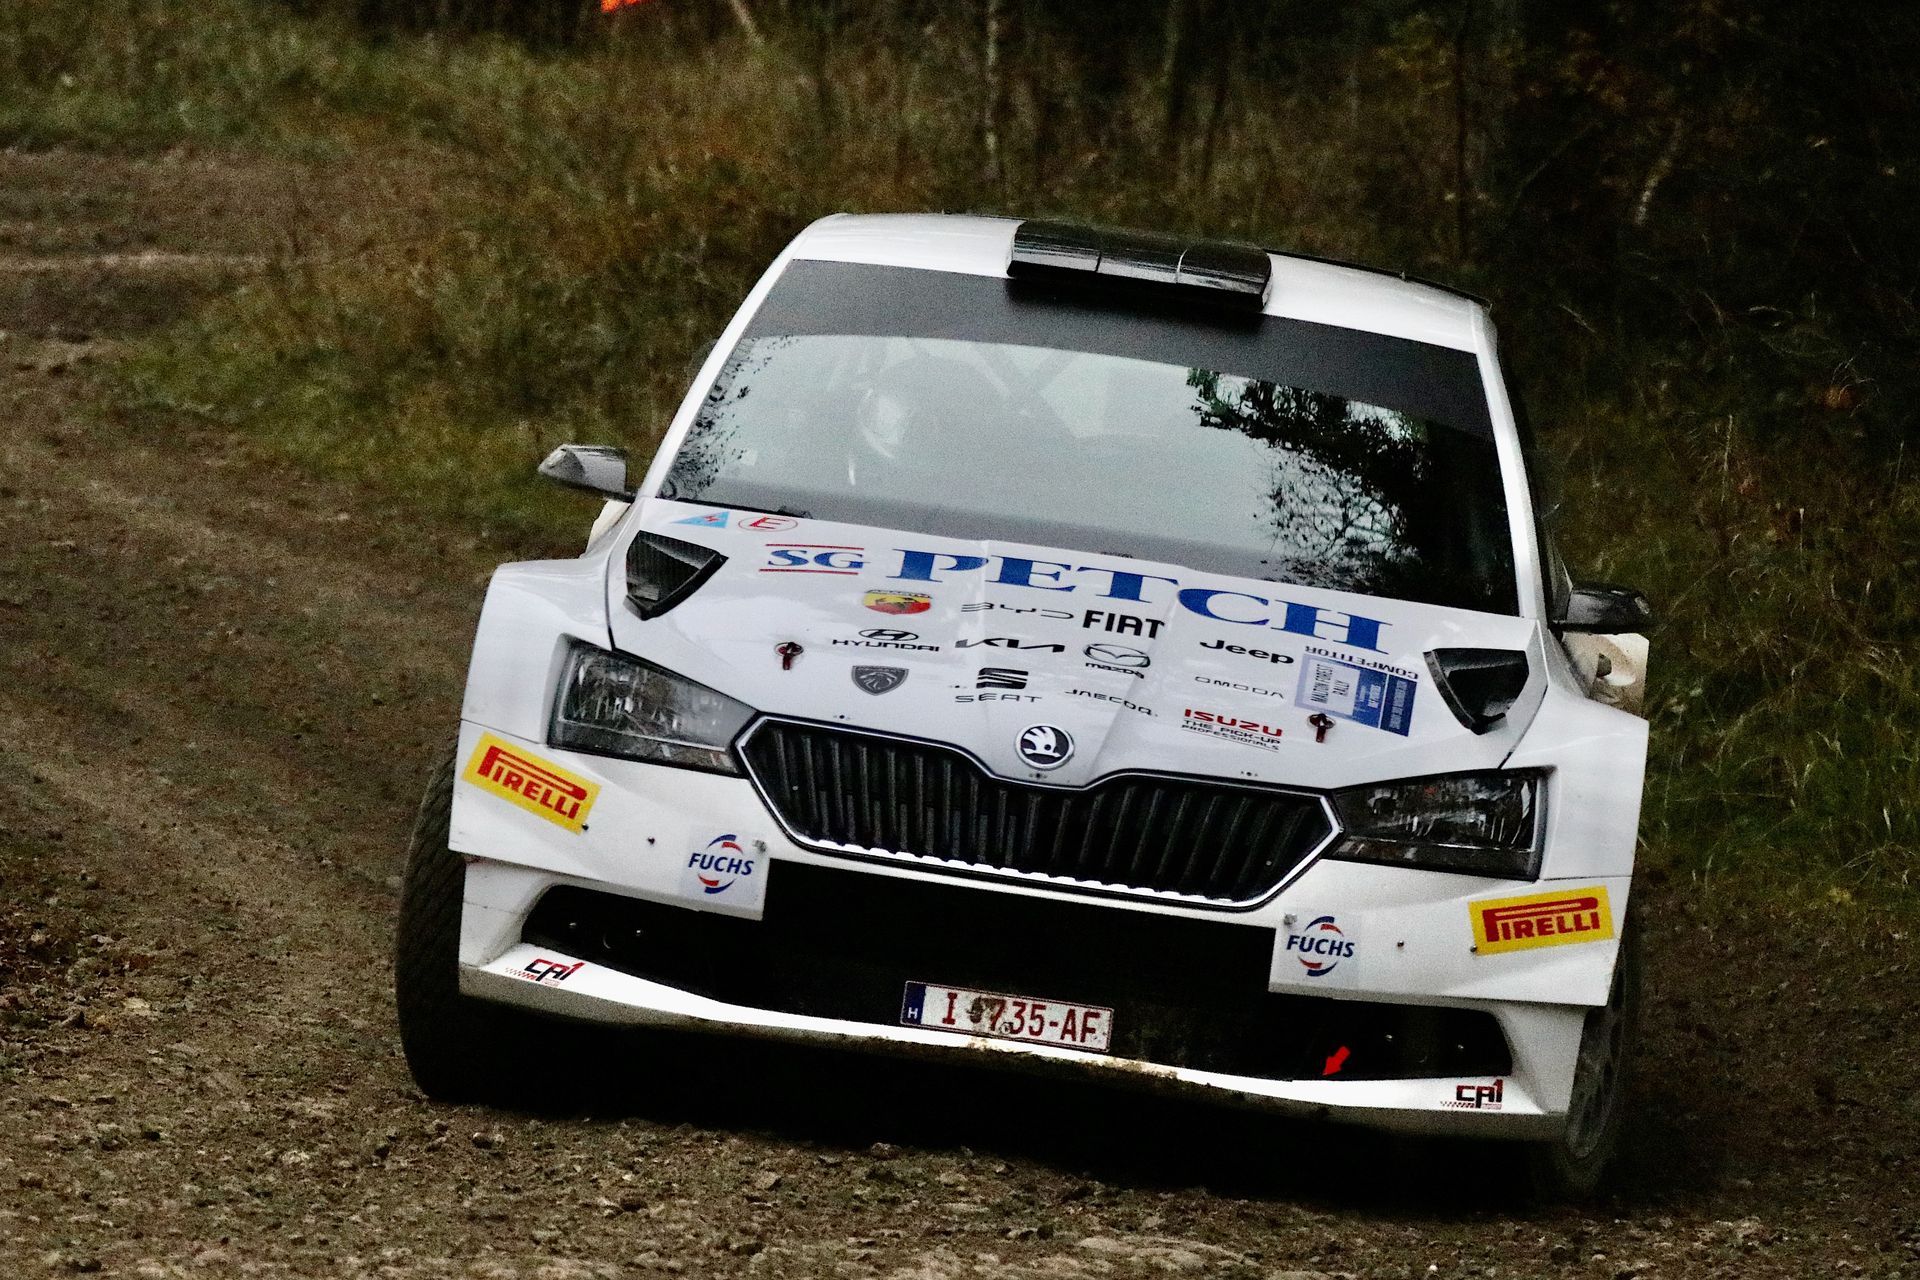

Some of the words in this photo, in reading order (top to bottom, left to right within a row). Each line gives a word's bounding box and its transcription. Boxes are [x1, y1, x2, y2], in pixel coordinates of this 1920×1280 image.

[767, 550, 871, 569] SG
[886, 548, 1393, 655] PETCH
[1082, 609, 1165, 640] FIAT
[832, 639, 940, 652] HYUNDAI
[1200, 639, 1294, 664] Jeep
[1085, 662, 1145, 679] mazda
[1304, 646, 1419, 680] COMPETITOR
[955, 693, 1043, 703] SEAT
[1194, 676, 1284, 699] OMODA
[1184, 708, 1283, 737] ISUZU
[1184, 719, 1213, 730] THE
[1220, 727, 1281, 744] PICK-UP
[477, 745, 588, 820] PIRELLI
[688, 852, 754, 876] FUCHS
[1482, 897, 1600, 943] PIRELLI
[1286, 934, 1355, 958] FUCHS
[907, 1006, 919, 1020] H
